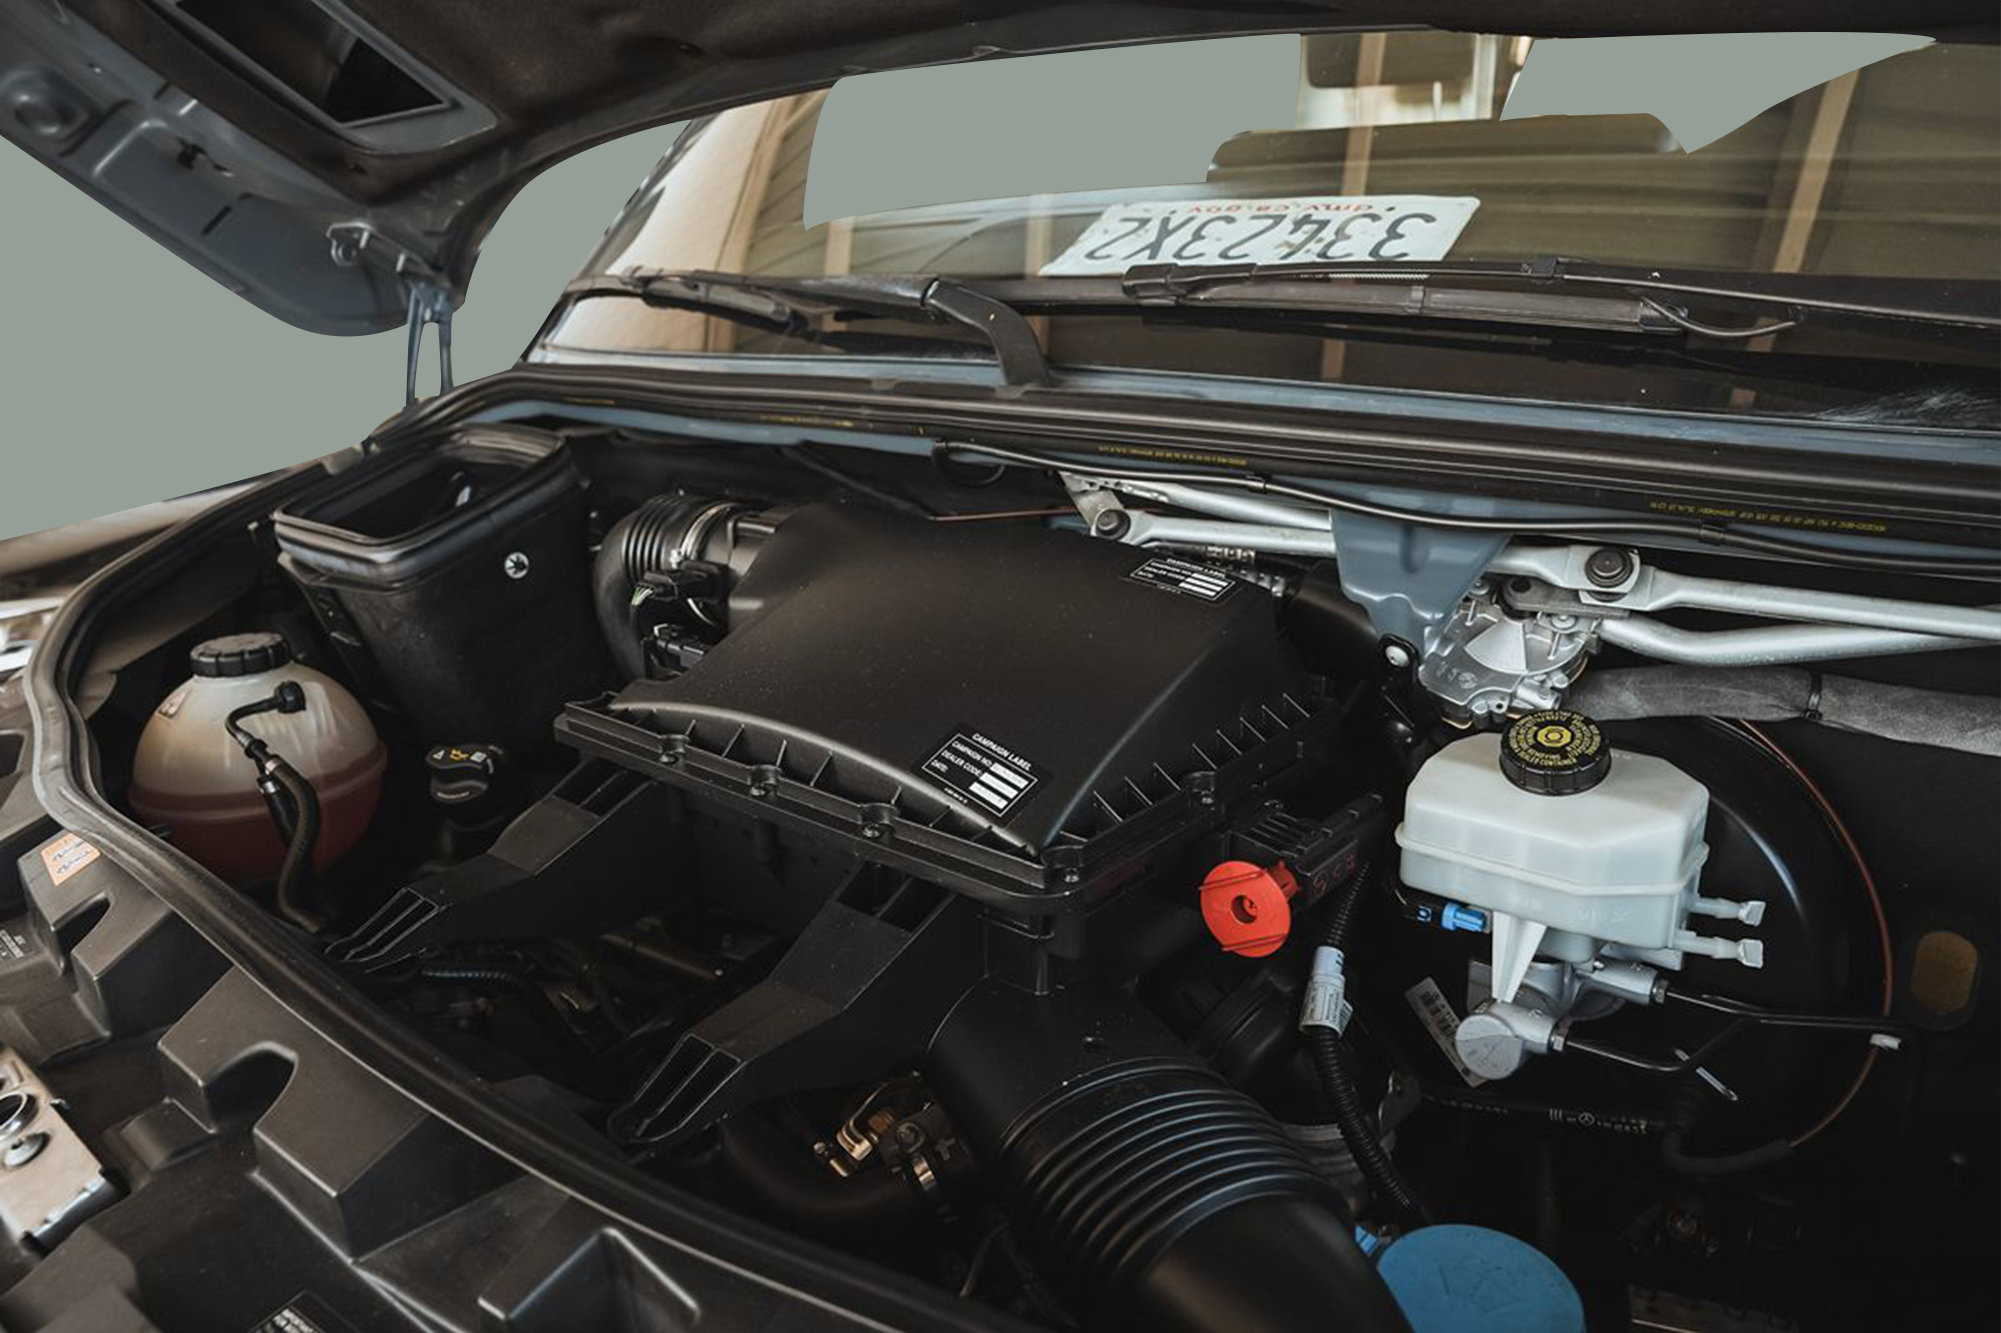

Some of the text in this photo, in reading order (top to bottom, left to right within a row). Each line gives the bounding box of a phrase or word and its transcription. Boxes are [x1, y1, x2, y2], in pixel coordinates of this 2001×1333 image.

[1085, 212, 1437, 260] 33423X2
[972, 732, 1032, 771] CAMPAIGN LABEL
